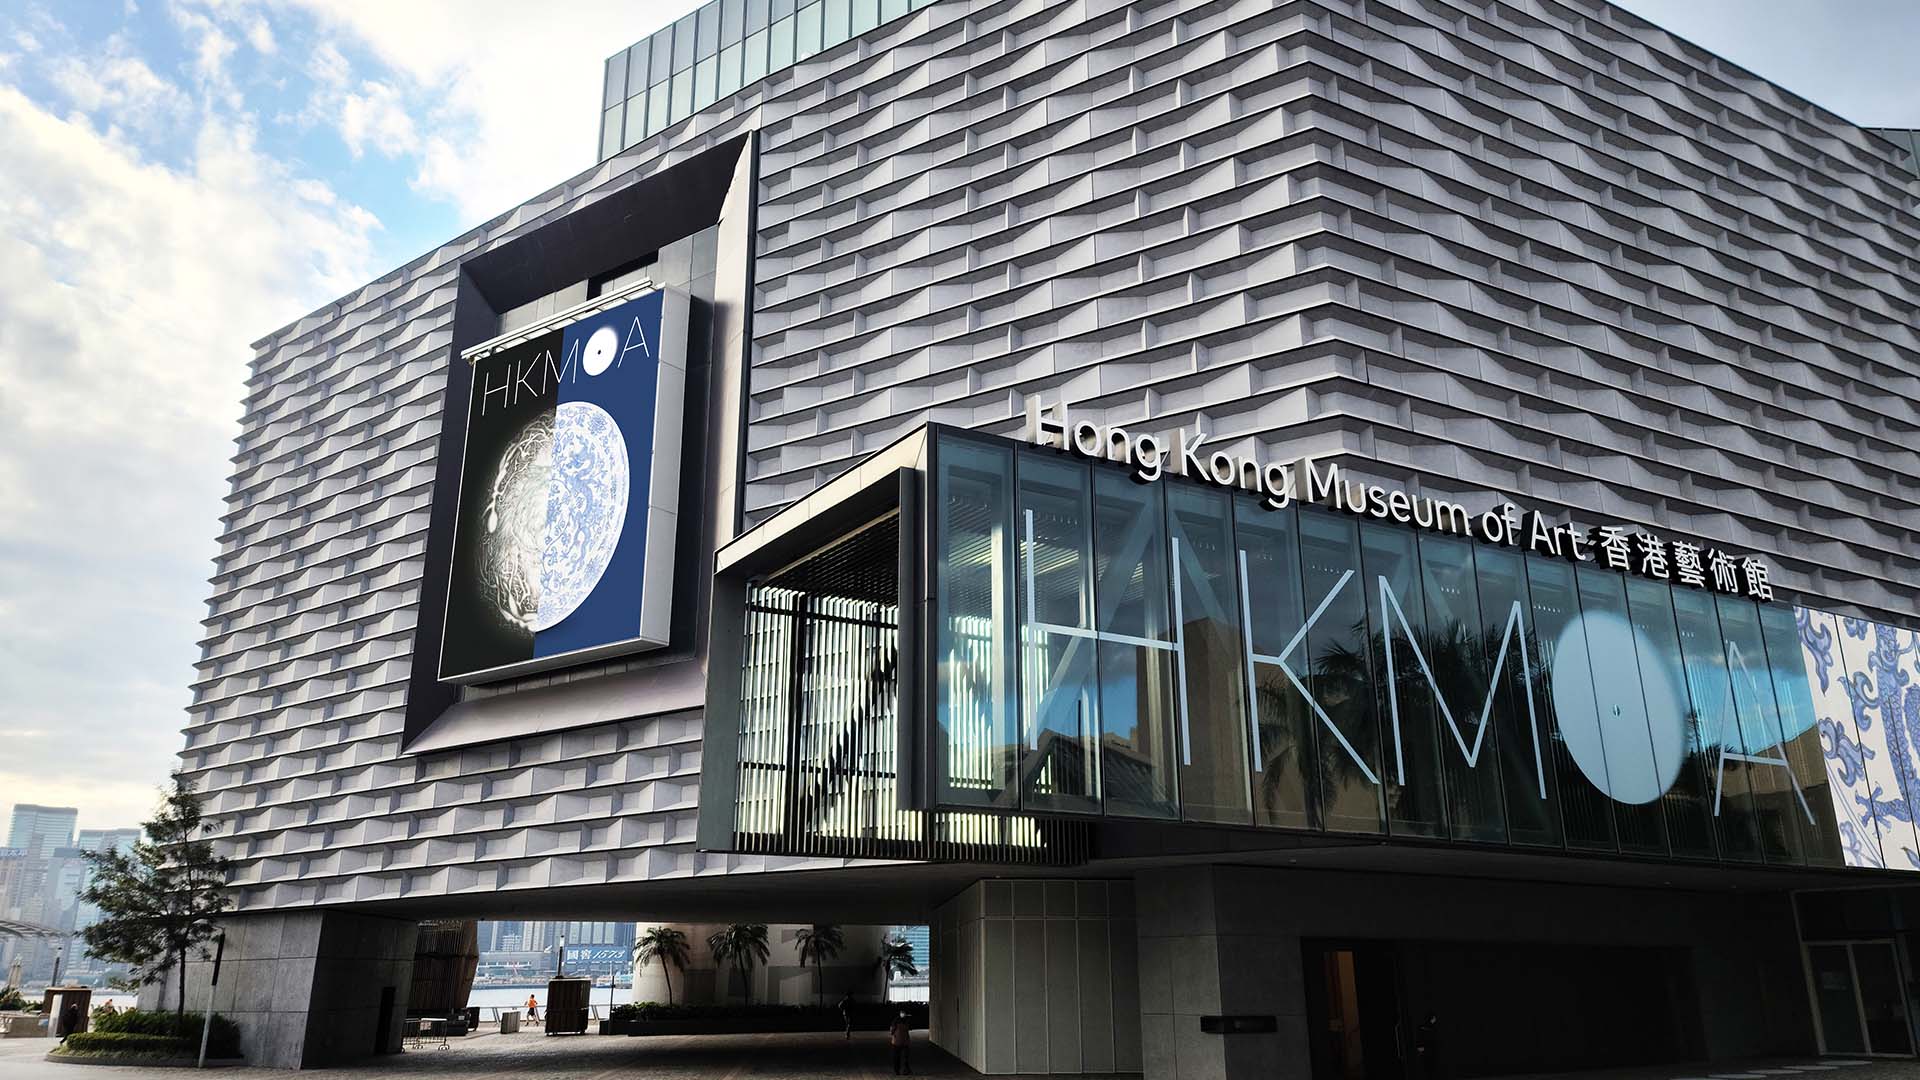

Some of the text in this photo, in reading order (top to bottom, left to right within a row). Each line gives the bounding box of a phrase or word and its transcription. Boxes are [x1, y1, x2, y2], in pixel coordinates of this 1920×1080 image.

[481, 316, 650, 416] HKMOA
[1034, 394, 1774, 601] Hong Kong Museum of Art 香港藝術館
[1025, 509, 1816, 825] HKMOA
